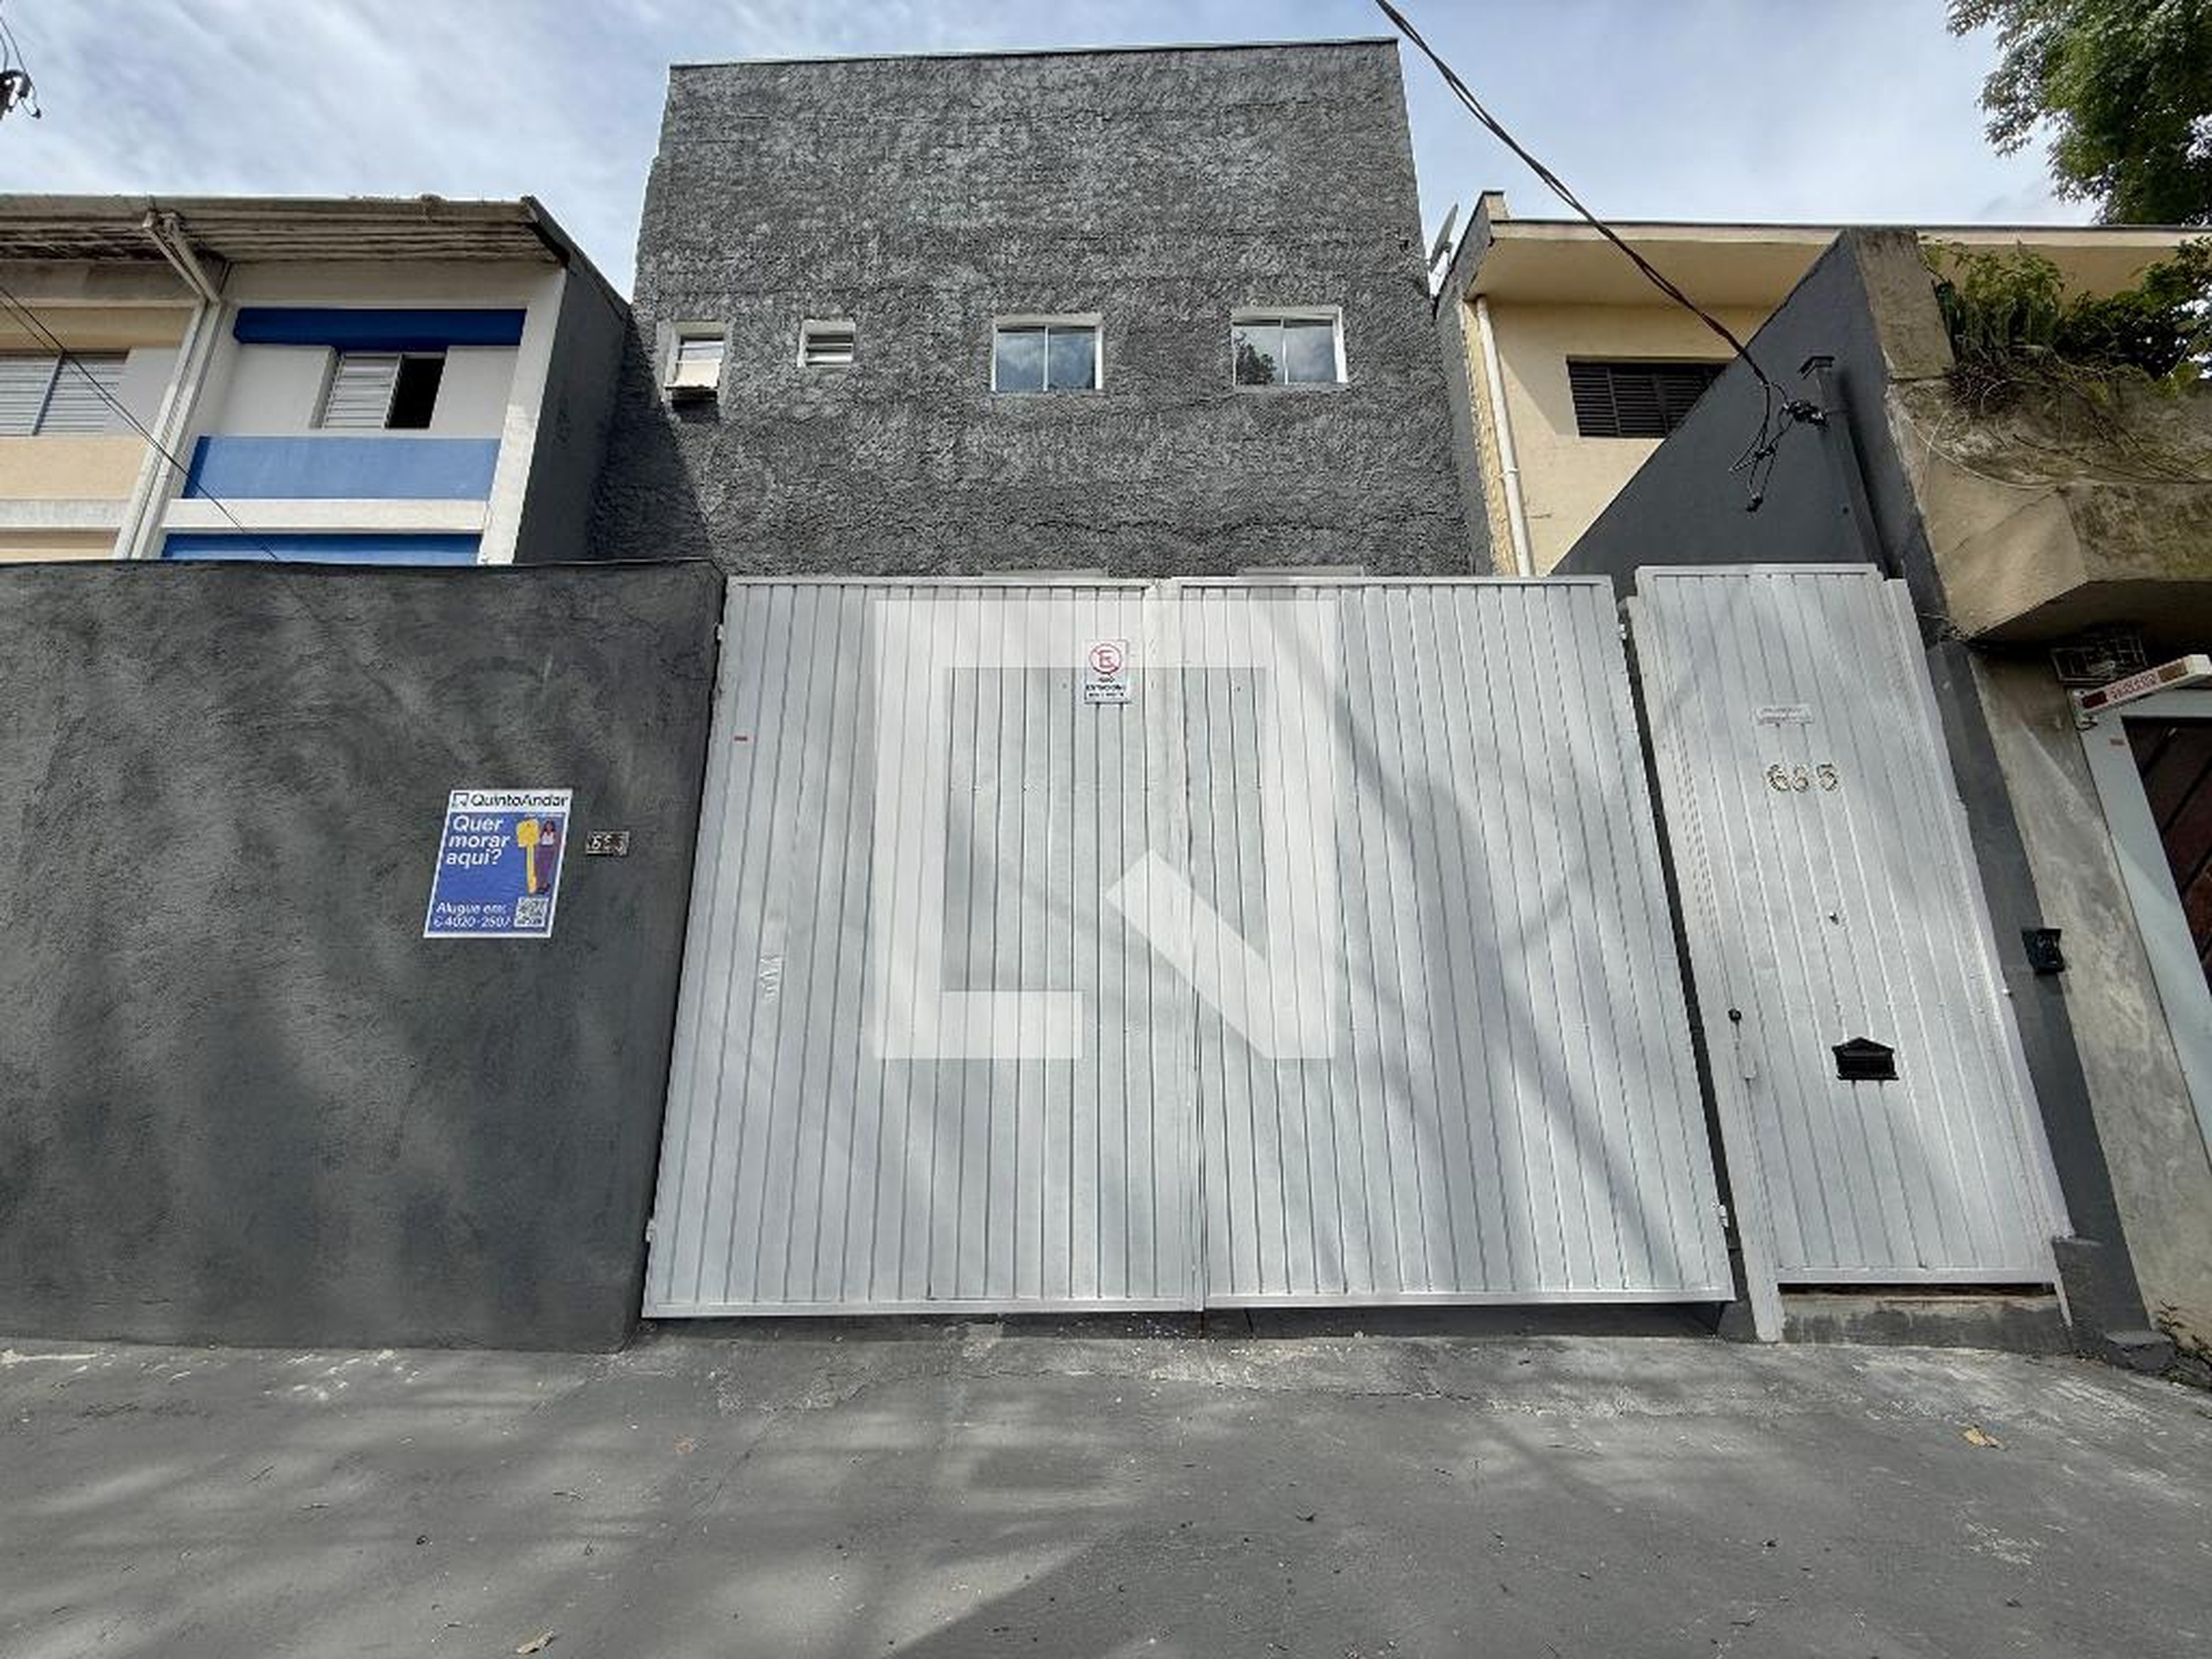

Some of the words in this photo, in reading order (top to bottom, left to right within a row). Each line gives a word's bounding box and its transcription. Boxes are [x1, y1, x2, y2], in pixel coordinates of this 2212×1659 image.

[471, 794, 568, 806] QuintoAndar
[453, 815, 504, 832] Quer
[448, 835, 511, 848] morar
[446, 849, 502, 869] aqui?
[435, 902, 481, 916] Alugue
